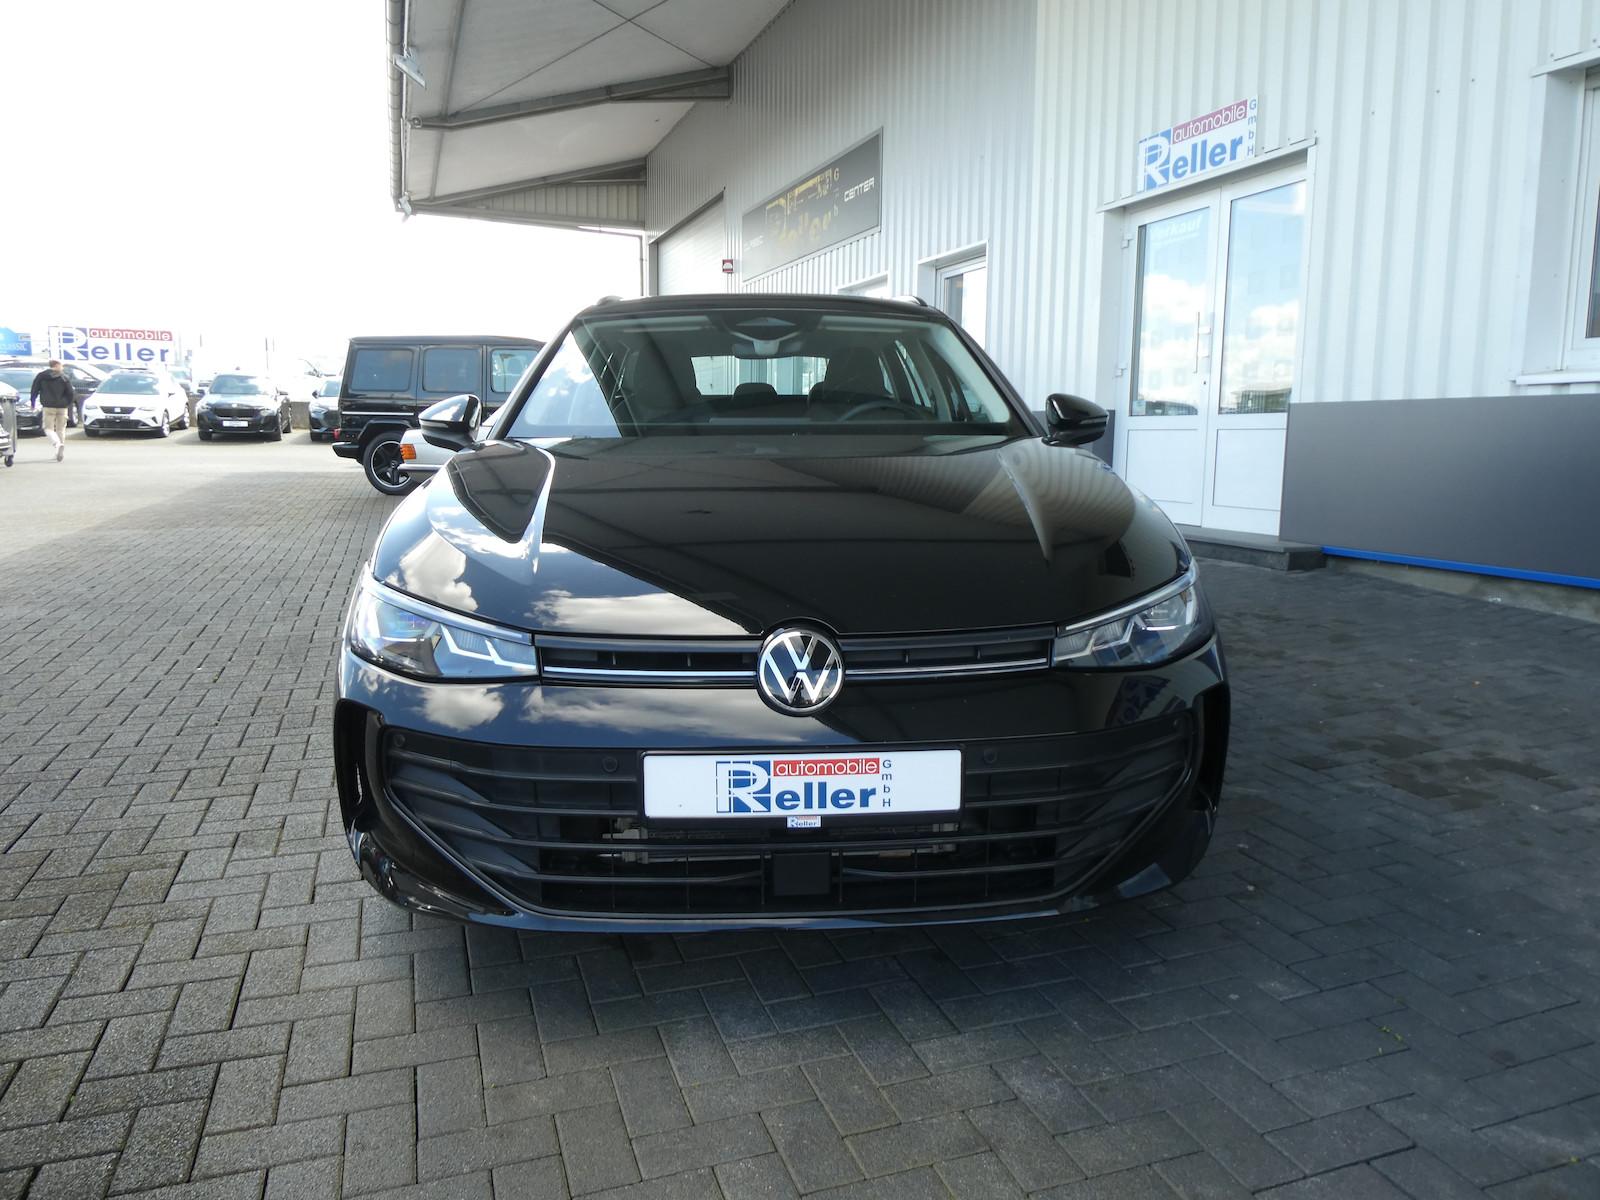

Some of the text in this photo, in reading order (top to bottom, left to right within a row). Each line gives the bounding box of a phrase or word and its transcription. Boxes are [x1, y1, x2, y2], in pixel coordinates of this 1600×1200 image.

[1173, 105, 1246, 143] automobile
[1137, 129, 1243, 192] Reller
[843, 177, 875, 202] CENTER
[49, 327, 169, 362] Reller
[89, 328, 172, 341] automobile
[763, 632, 838, 705] VW
[776, 760, 878, 776] automobile
[716, 761, 877, 813] Reller
